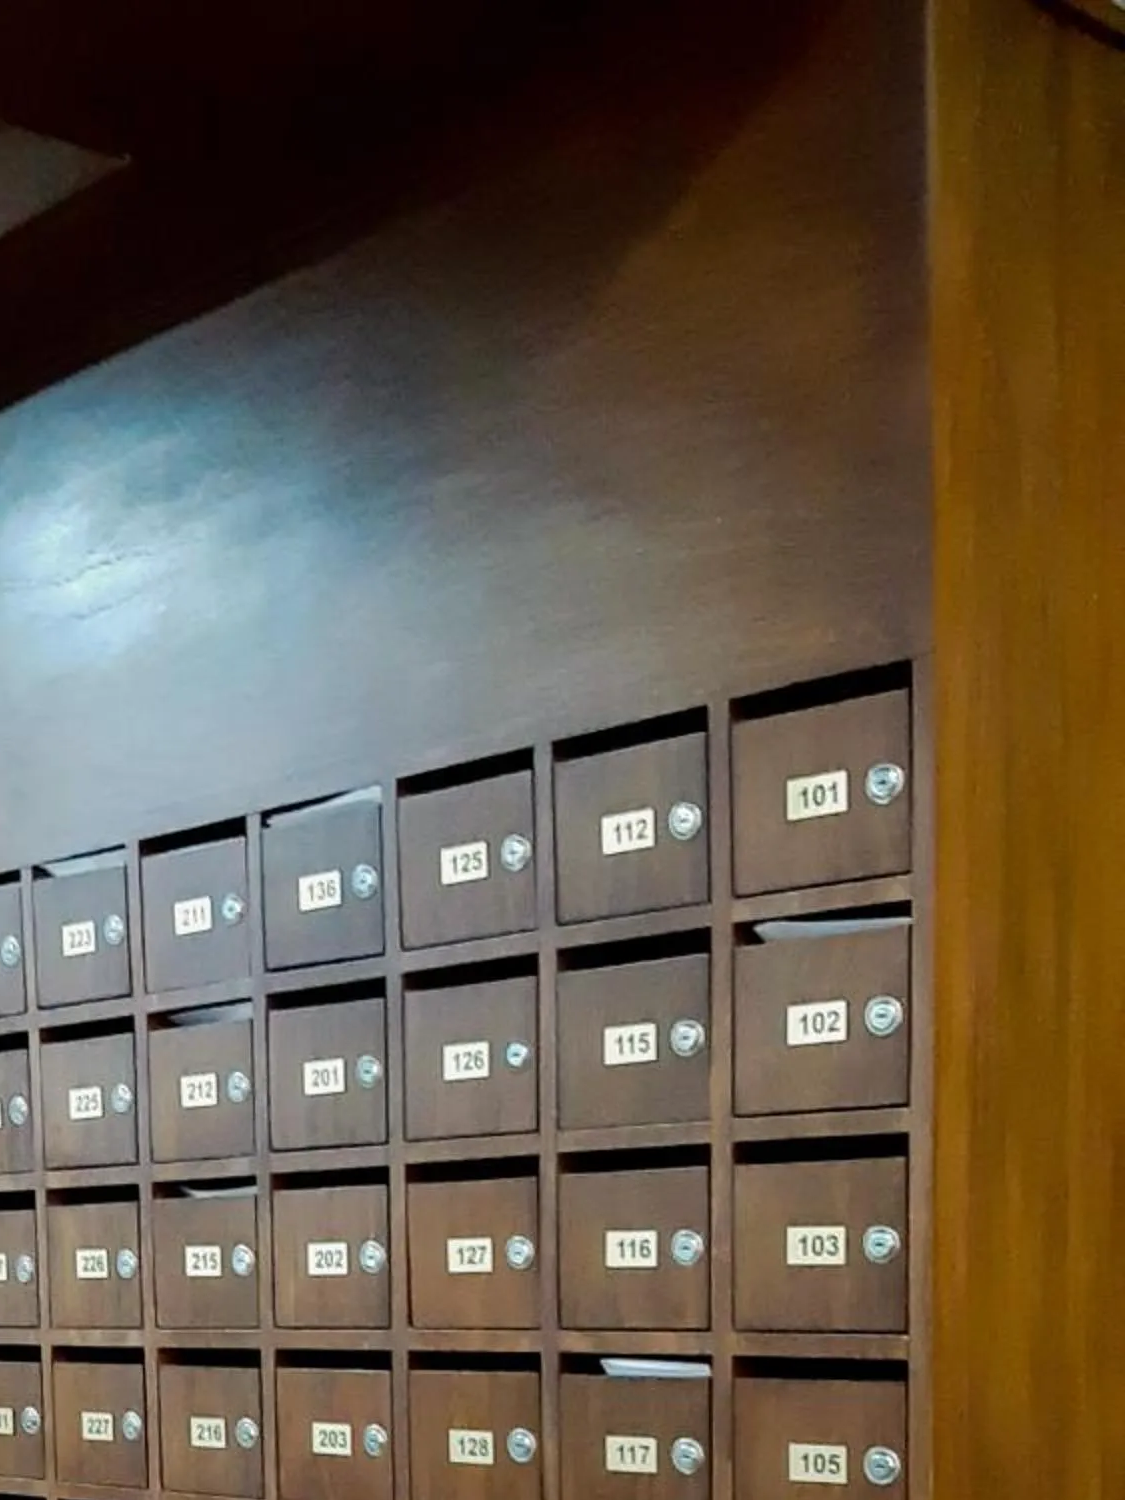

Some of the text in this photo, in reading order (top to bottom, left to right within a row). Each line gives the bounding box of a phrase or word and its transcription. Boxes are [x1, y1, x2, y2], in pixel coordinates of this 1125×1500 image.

[798, 781, 840, 812] 101
[612, 818, 649, 847] 112
[450, 850, 483, 878] 125
[307, 878, 337, 905] 136
[181, 904, 207, 929] 211
[68, 928, 92, 950] 223
[798, 1010, 841, 1038] 102
[614, 1032, 652, 1058] 115
[452, 1050, 485, 1074] 126
[311, 1066, 340, 1090] 201
[187, 1081, 214, 1102] 212
[75, 1094, 99, 1113] 225
[456, 1246, 488, 1267] 127
[616, 1239, 652, 1261] 116
[798, 1235, 840, 1258] 103
[81, 1256, 104, 1273] 226
[191, 1253, 219, 1271] 215
[315, 1250, 344, 1270] 202
[87, 1418, 110, 1435] 227
[196, 1424, 223, 1443] 216
[319, 1430, 348, 1450] 203
[458, 1437, 490, 1459] 128
[616, 1444, 652, 1467] 117
[800, 1452, 842, 1477] 105
